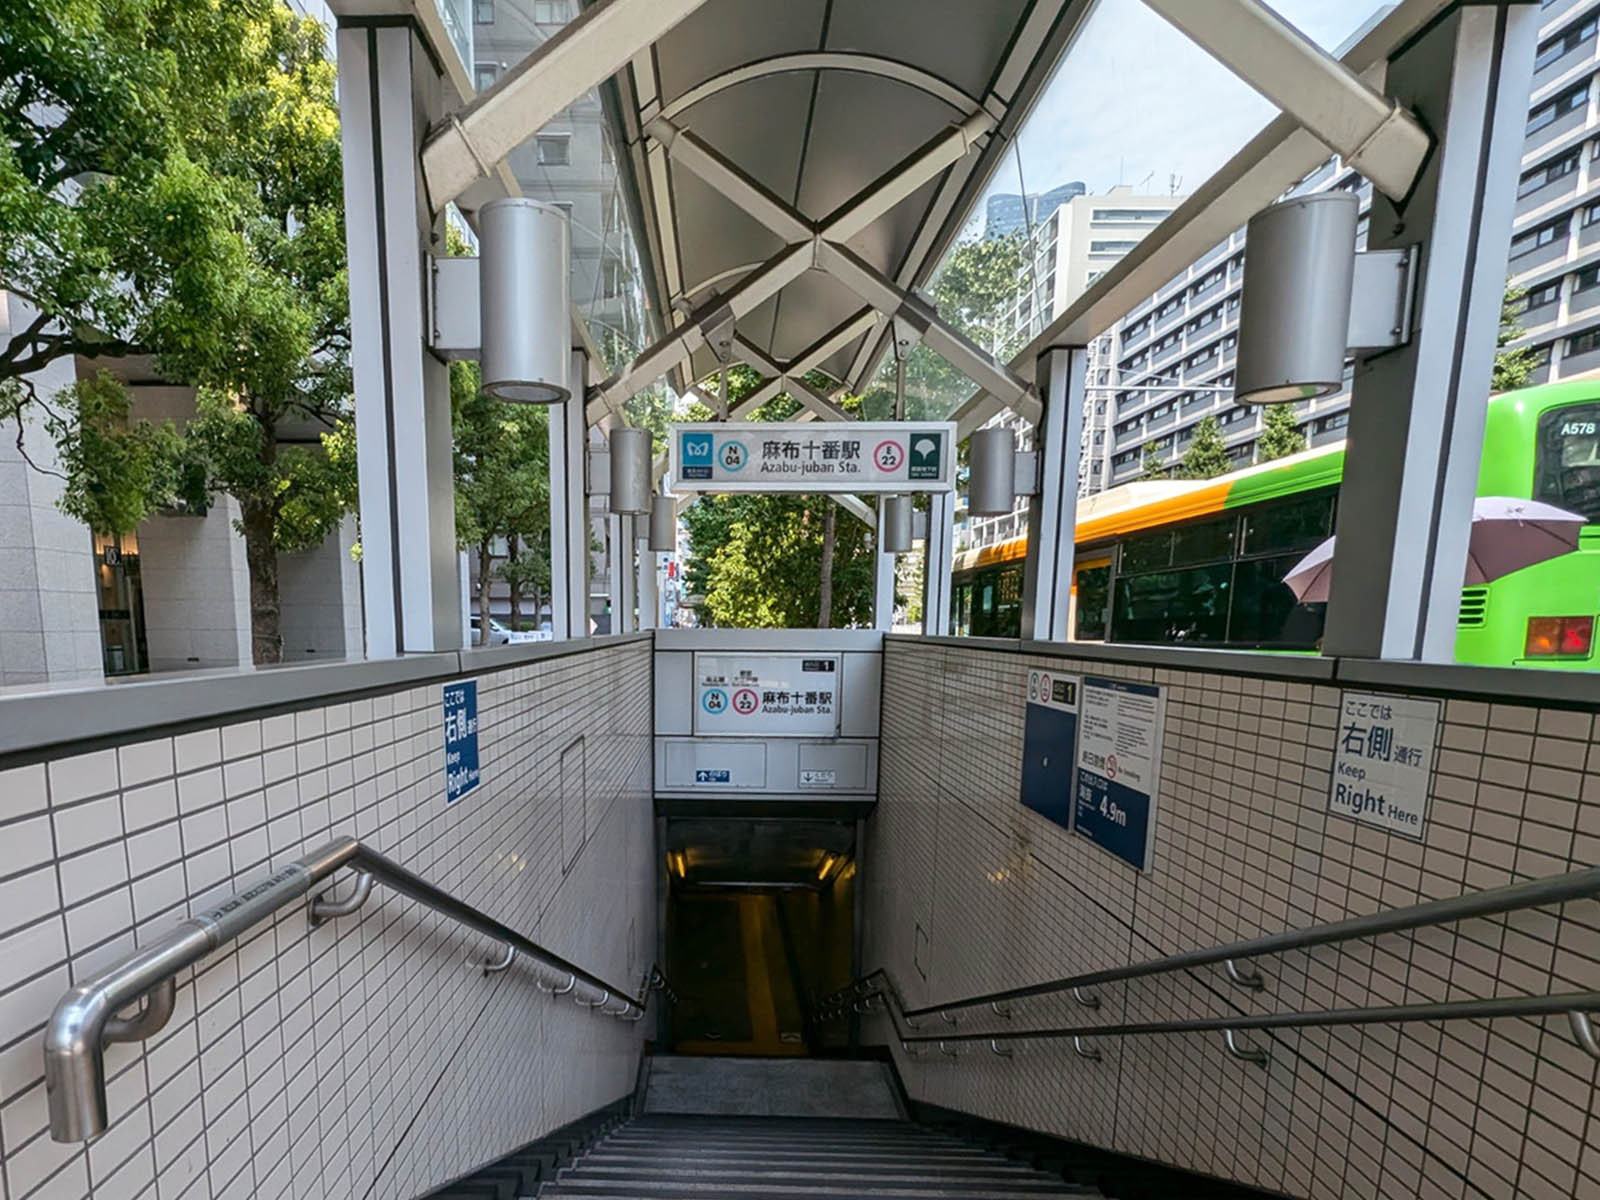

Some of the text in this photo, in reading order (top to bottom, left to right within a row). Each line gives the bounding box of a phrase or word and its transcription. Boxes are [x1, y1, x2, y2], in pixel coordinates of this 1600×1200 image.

[1561, 422, 1596, 435] A578
[729, 446, 738, 454] N
[762, 440, 861, 460] 麻布十番駅
[886, 446, 892, 455] E
[726, 455, 740, 466] 04
[881, 456, 896, 465] 22
[760, 461, 861, 475] Azabu-juban Sta.
[445, 689, 465, 707] ここでは
[740, 700, 752, 709] 22
[762, 691, 832, 705] 麻布十番駅
[762, 705, 832, 715] Azabu-juban Sta.
[1345, 701, 1392, 721] ここでは
[1337, 761, 1366, 781] Keep
[448, 766, 468, 795] Right
[1100, 795, 1126, 827] 4.9m
[1335, 783, 1418, 825] Right Here
